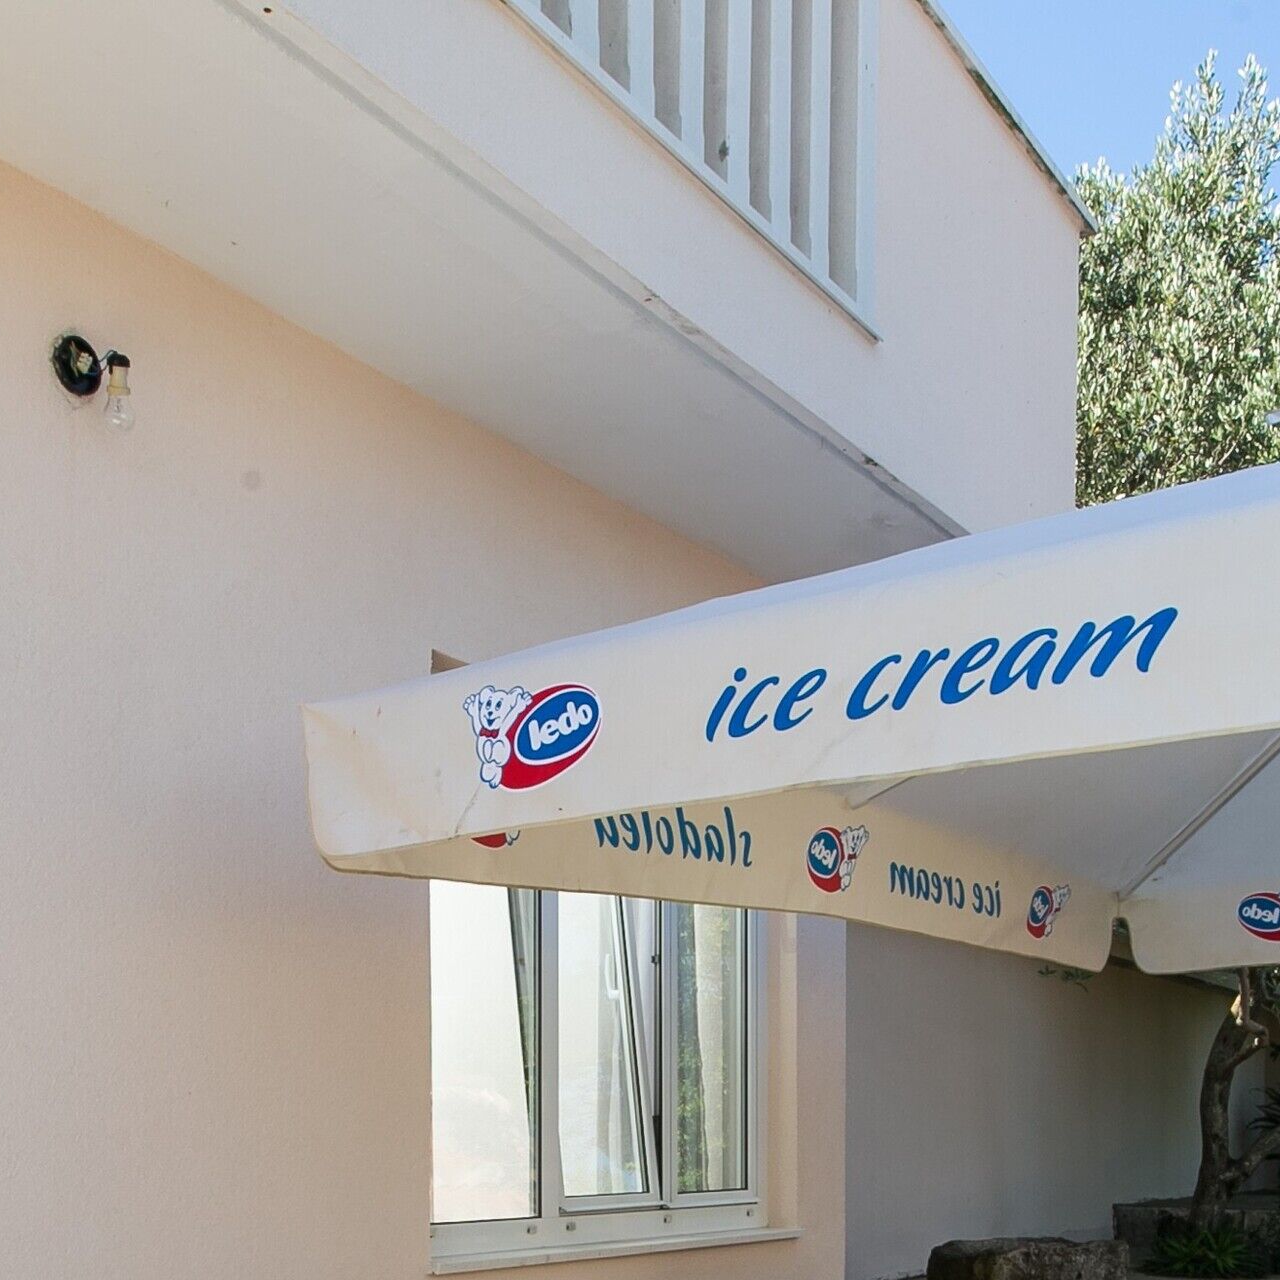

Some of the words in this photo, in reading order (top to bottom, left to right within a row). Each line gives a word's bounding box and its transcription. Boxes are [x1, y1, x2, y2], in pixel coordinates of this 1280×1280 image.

[706, 667, 827, 742] ice
[846, 606, 1179, 720] cream
[528, 701, 593, 750] ledo
